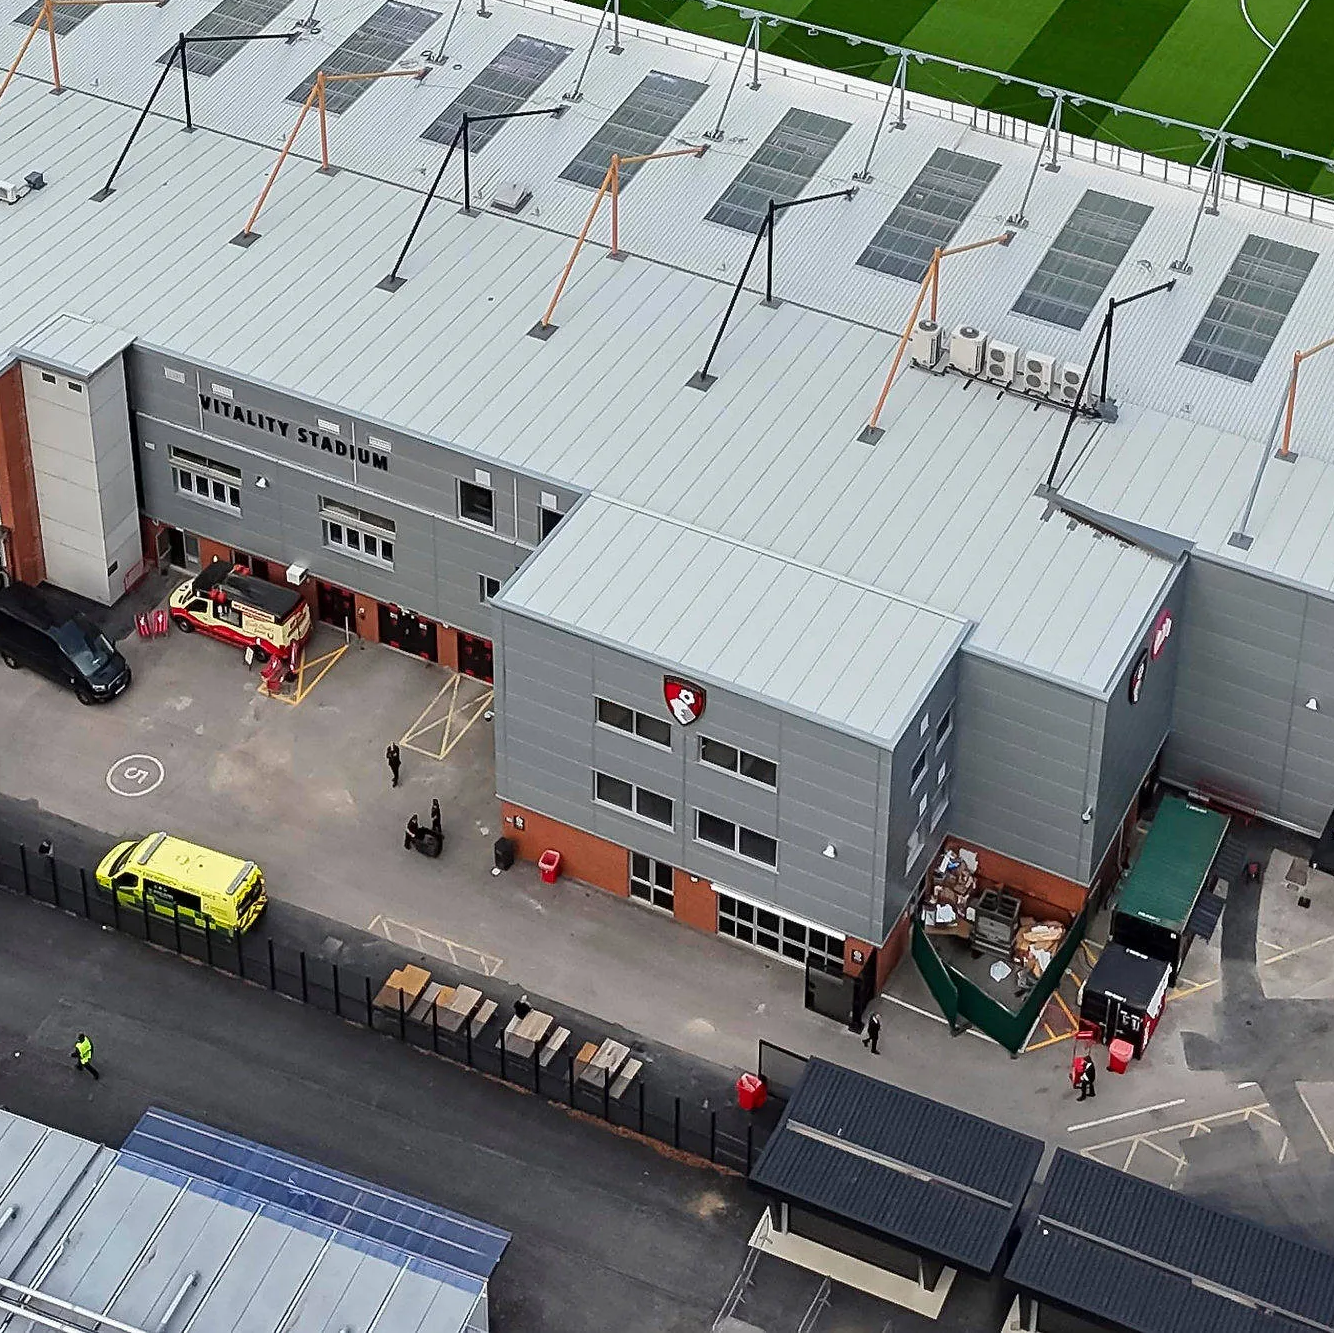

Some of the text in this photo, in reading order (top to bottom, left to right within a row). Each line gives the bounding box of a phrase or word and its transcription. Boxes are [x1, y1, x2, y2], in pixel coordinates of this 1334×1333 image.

[198, 394, 389, 471] VITALITY STADIUM
[124, 767, 150, 784] 5
